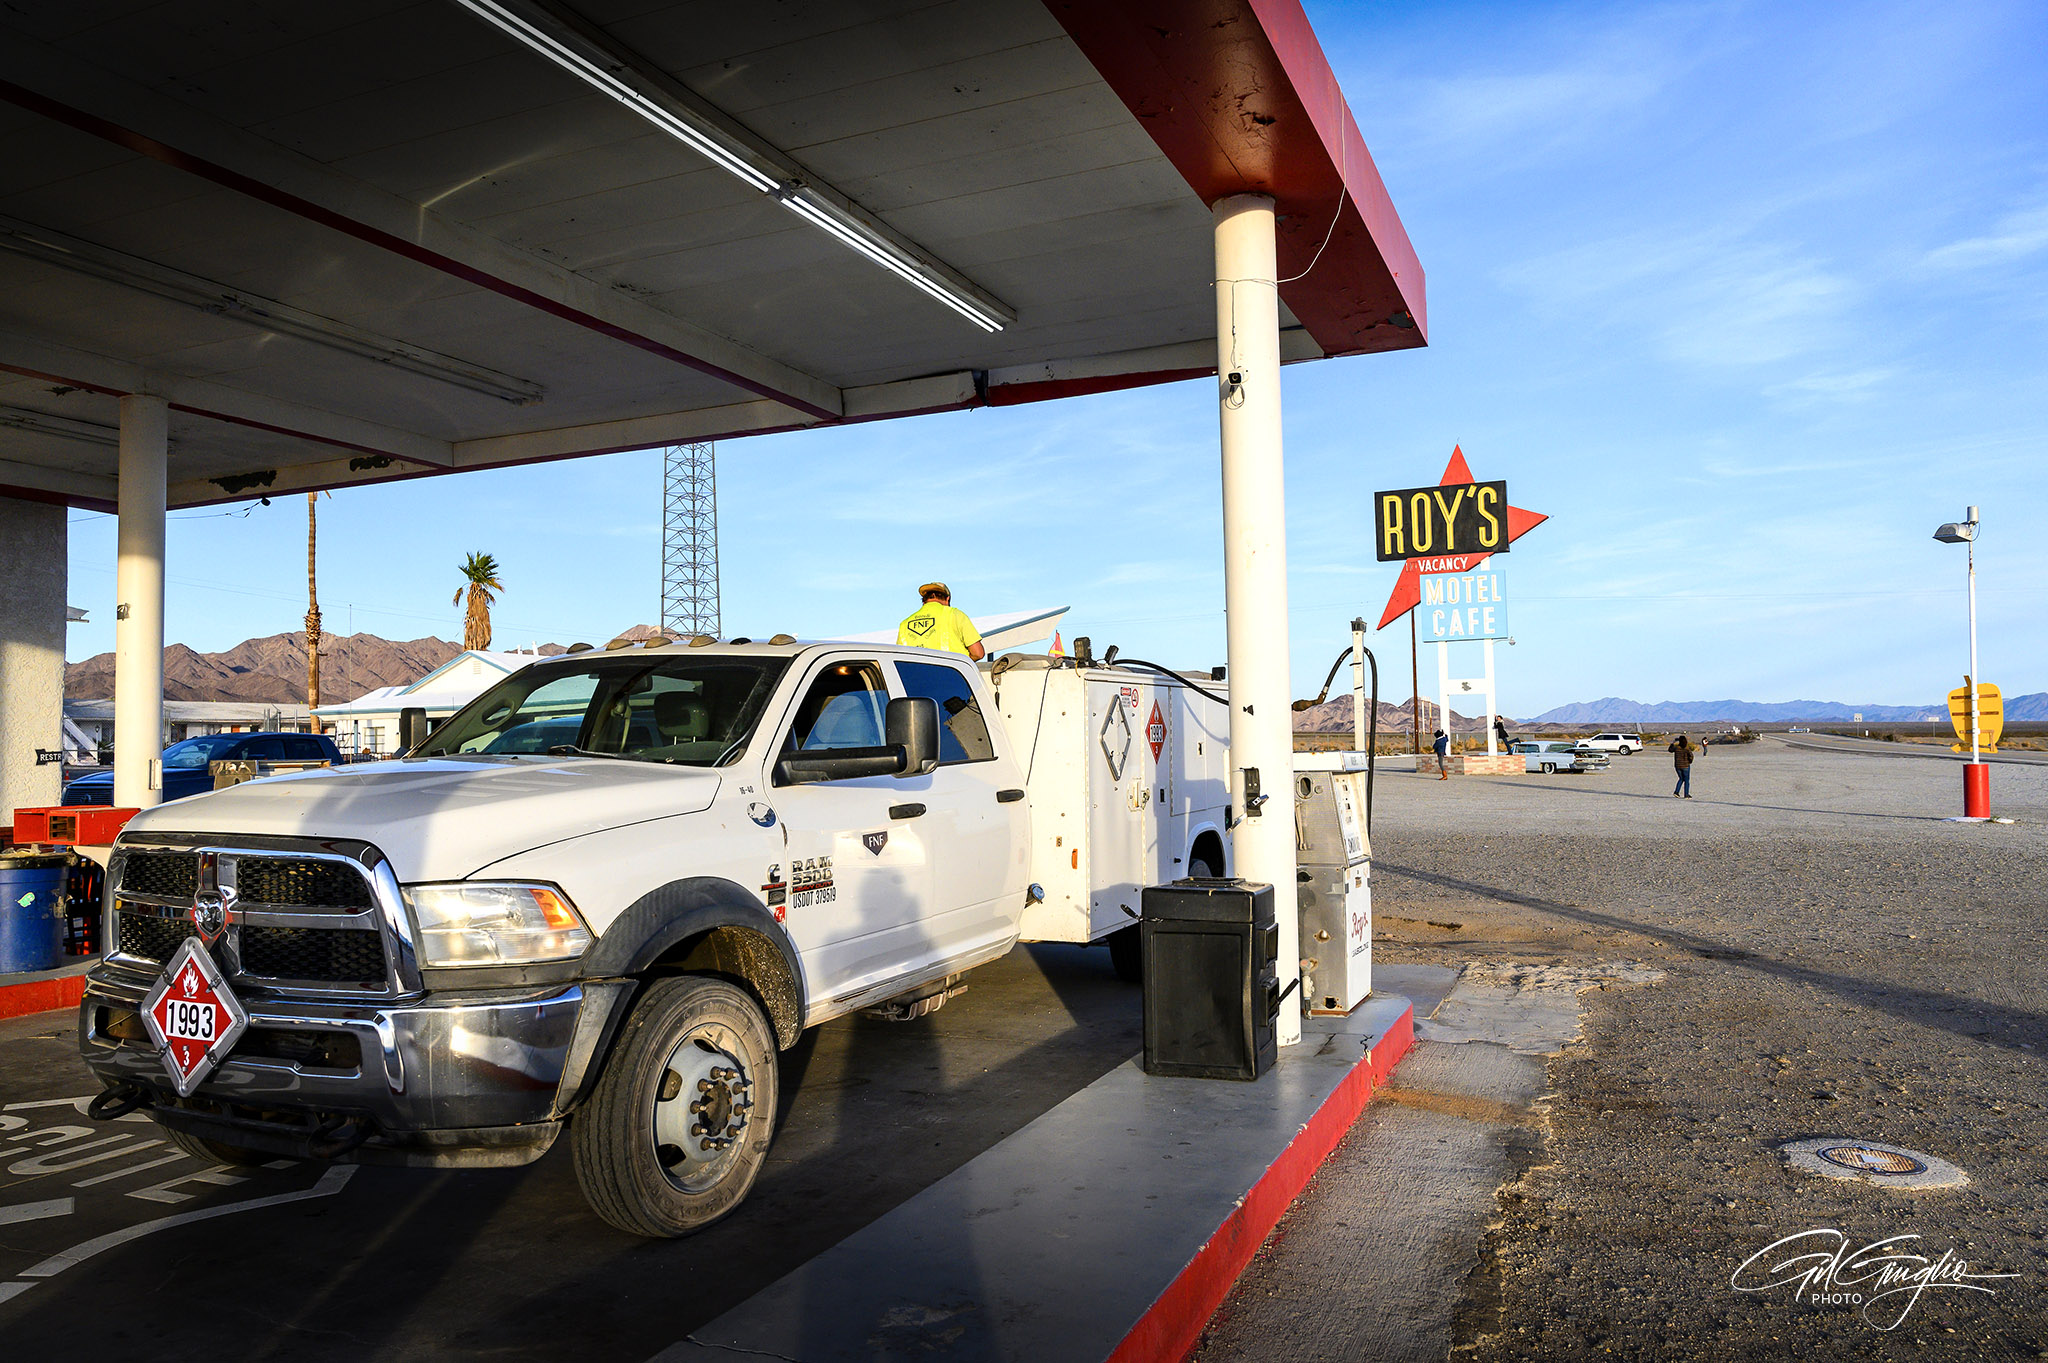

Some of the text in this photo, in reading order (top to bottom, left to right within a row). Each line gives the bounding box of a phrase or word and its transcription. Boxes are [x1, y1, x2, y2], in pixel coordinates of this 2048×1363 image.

[1382, 485, 1499, 556] ROY'S
[1418, 556, 1468, 573] VACANCY
[1425, 575, 1502, 605] MOTEL
[913, 620, 929, 629] FNF
[1432, 606, 1496, 637] CAFE
[868, 834, 885, 847] FNF
[792, 856, 833, 873] RAM
[793, 891, 814, 909] USDOT
[168, 1001, 213, 1039] 1993
[183, 1050, 190, 1066] 3
